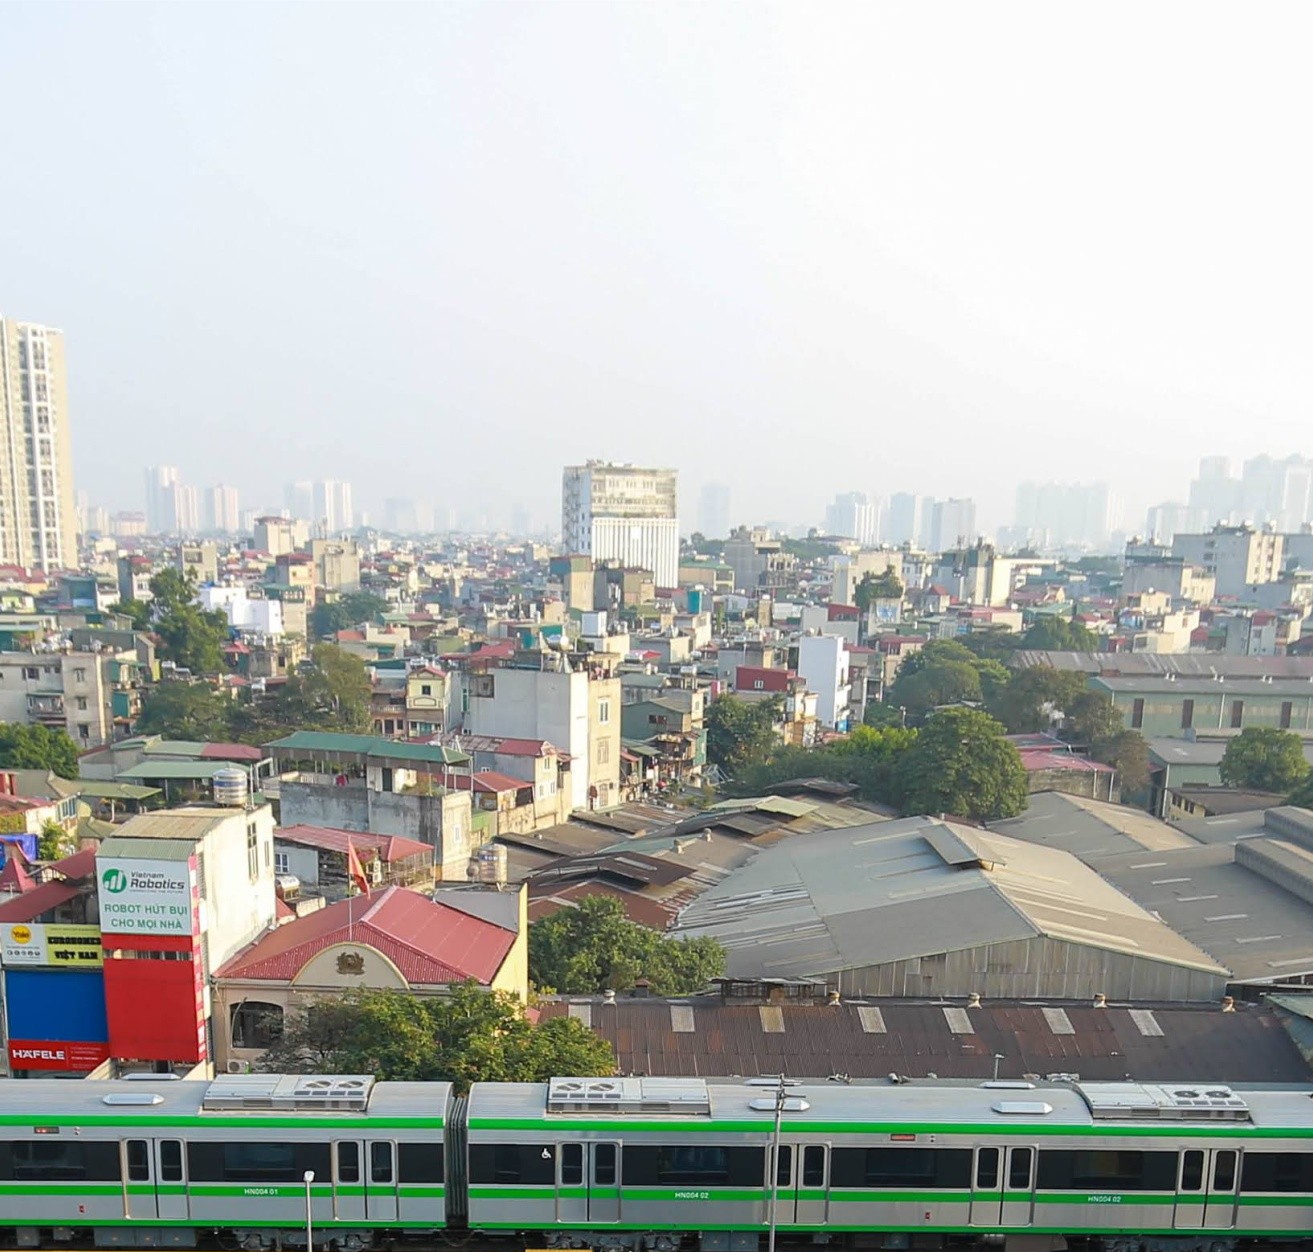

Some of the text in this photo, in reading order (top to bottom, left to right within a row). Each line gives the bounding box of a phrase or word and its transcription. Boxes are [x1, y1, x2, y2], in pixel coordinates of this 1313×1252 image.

[130, 871, 164, 879] Vietnam
[130, 878, 185, 890] Robotics
[104, 903, 188, 916] ROBOT HÚT BỤI
[111, 918, 134, 927] CHO
[137, 919, 157, 929] MỌI
[12, 1049, 65, 1060] HÄFELE
